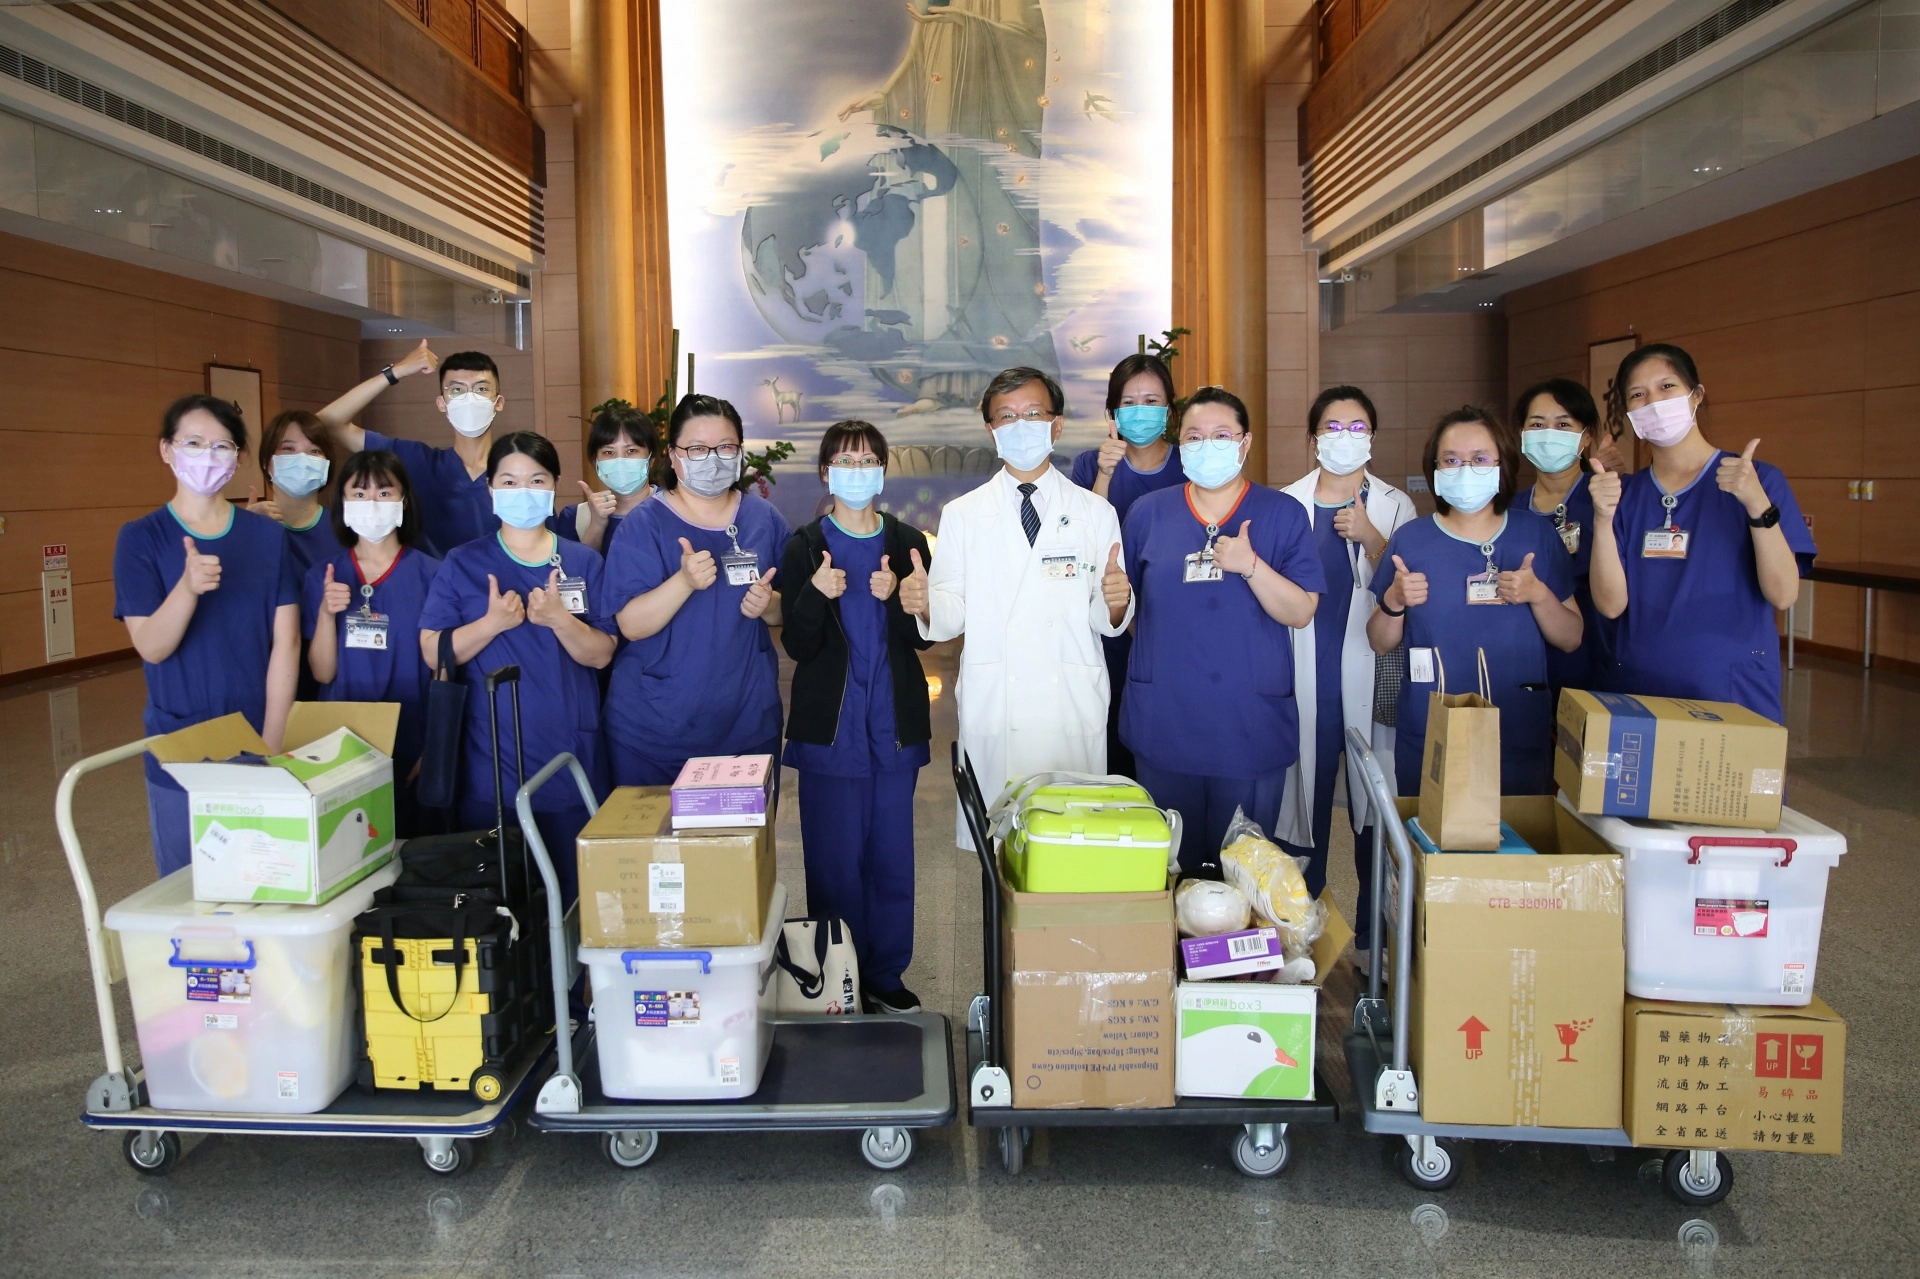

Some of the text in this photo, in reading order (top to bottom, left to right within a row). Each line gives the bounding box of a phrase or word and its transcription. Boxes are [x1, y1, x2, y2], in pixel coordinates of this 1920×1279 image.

[235, 804, 265, 816] box3
[1230, 999, 1262, 1010] box3
[1108, 1016, 1126, 1024] KGS
[1103, 1030, 1159, 1040] Colour: Yellow
[1085, 1048, 1124, 1056] 10pcs/bag,
[1126, 1047, 1158, 1055] Packing:
[1465, 1050, 1483, 1060] UP
[1032, 1062, 1158, 1072] Disposable PP+PE Isolation Gown
[1658, 1054, 1730, 1069] 即時庫存
[1766, 1062, 1779, 1071] UP
[1656, 1078, 1729, 1091] 流通加工
[1758, 1086, 1819, 1100] 易碎品
[1656, 1101, 1728, 1116] 網路平台
[1753, 1110, 1817, 1124] 小心輕放
[1655, 1125, 1728, 1140] 全省配送
[1752, 1130, 1816, 1145] 請勿重壓
